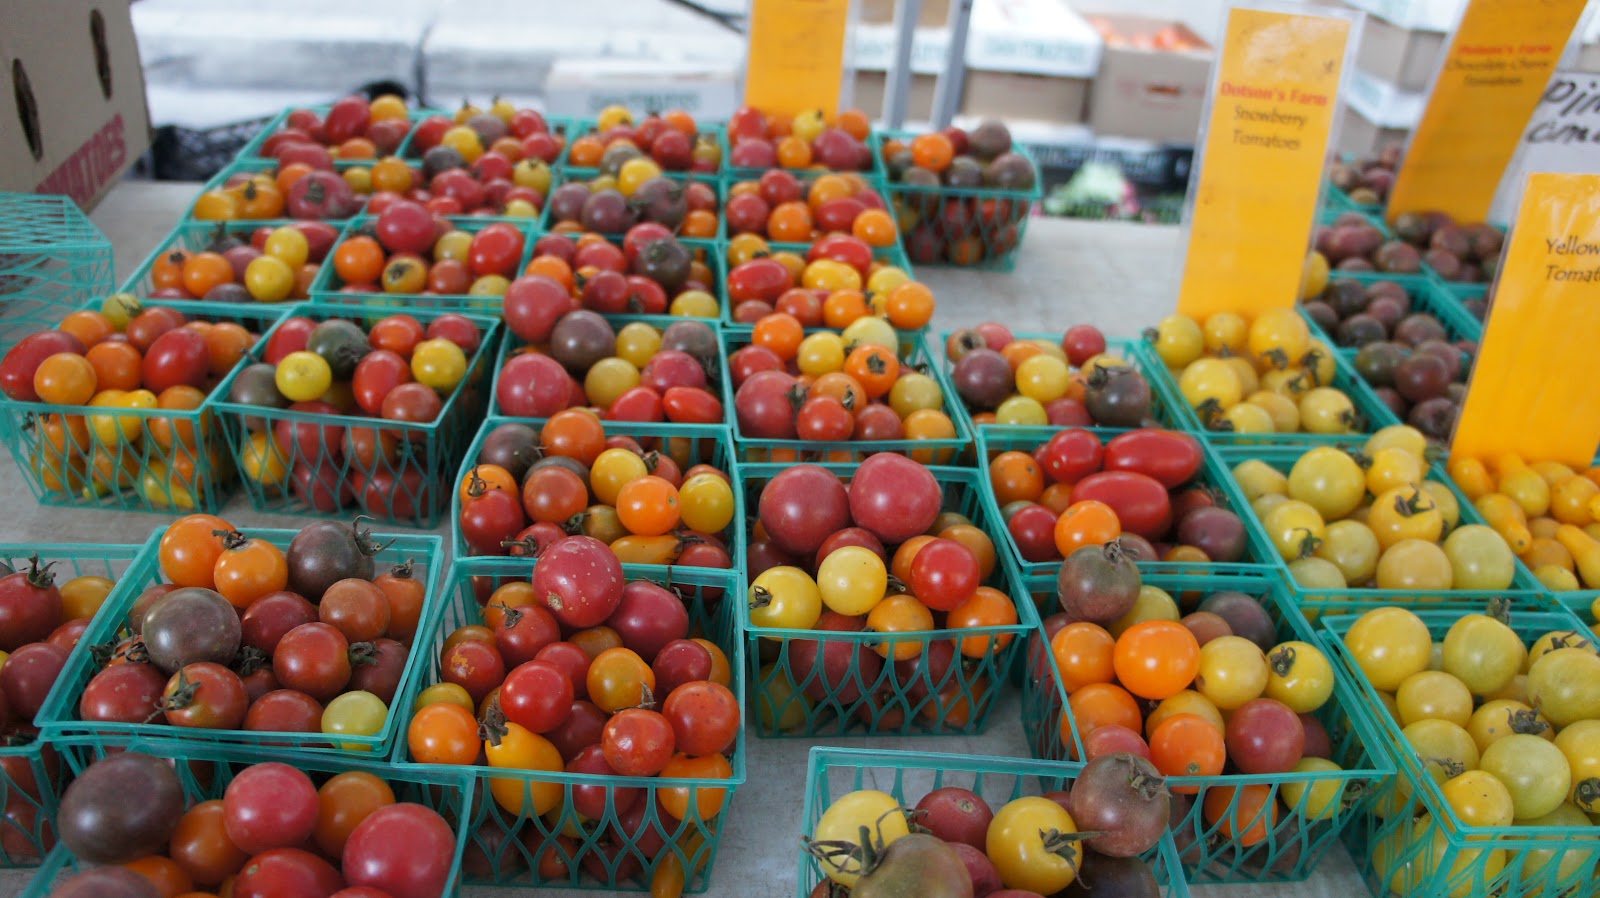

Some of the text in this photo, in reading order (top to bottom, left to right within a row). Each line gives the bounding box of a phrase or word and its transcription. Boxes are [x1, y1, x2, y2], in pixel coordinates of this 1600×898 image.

[1221, 82, 1328, 106] Dotson's Farm
[1233, 105, 1308, 129] Snowberry
[1232, 128, 1300, 149] Tomatoes
